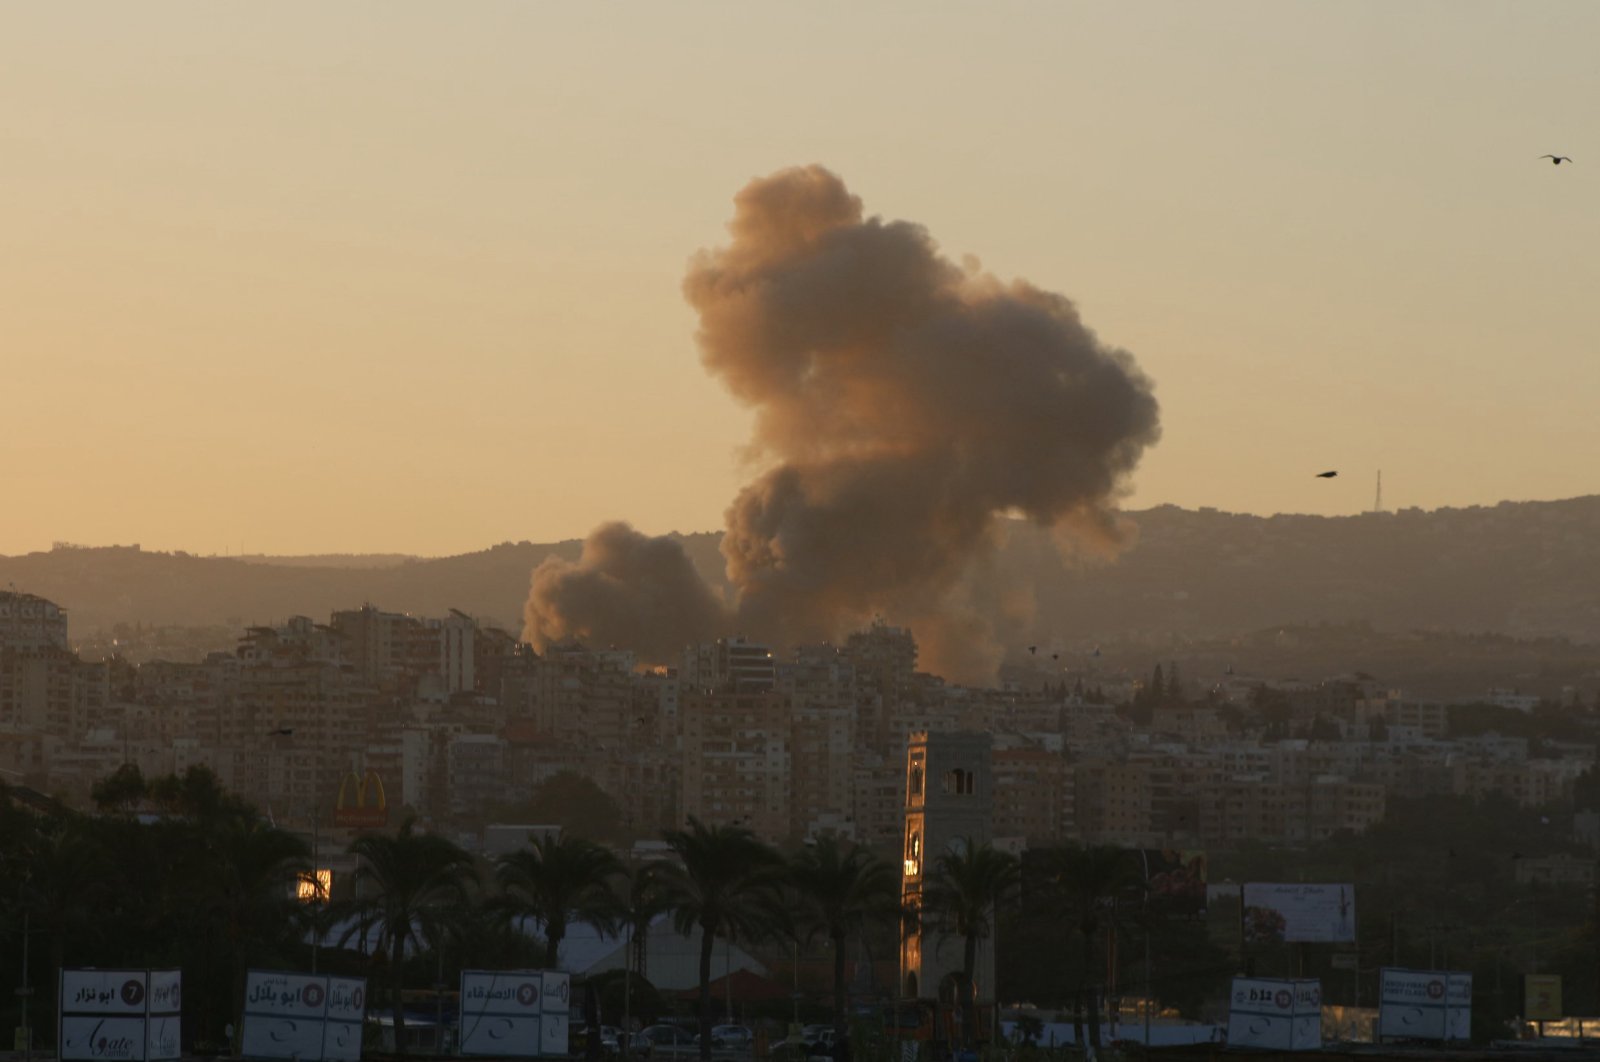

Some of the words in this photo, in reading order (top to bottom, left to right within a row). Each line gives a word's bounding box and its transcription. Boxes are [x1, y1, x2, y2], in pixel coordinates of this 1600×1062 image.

[75, 988, 96, 1002] نزار
[98, 988, 115, 1004] ابو
[128, 986, 138, 1000] 7
[249, 985, 277, 1006] بلال
[280, 987, 301, 1007] ابو
[523, 987, 532, 1001] 9
